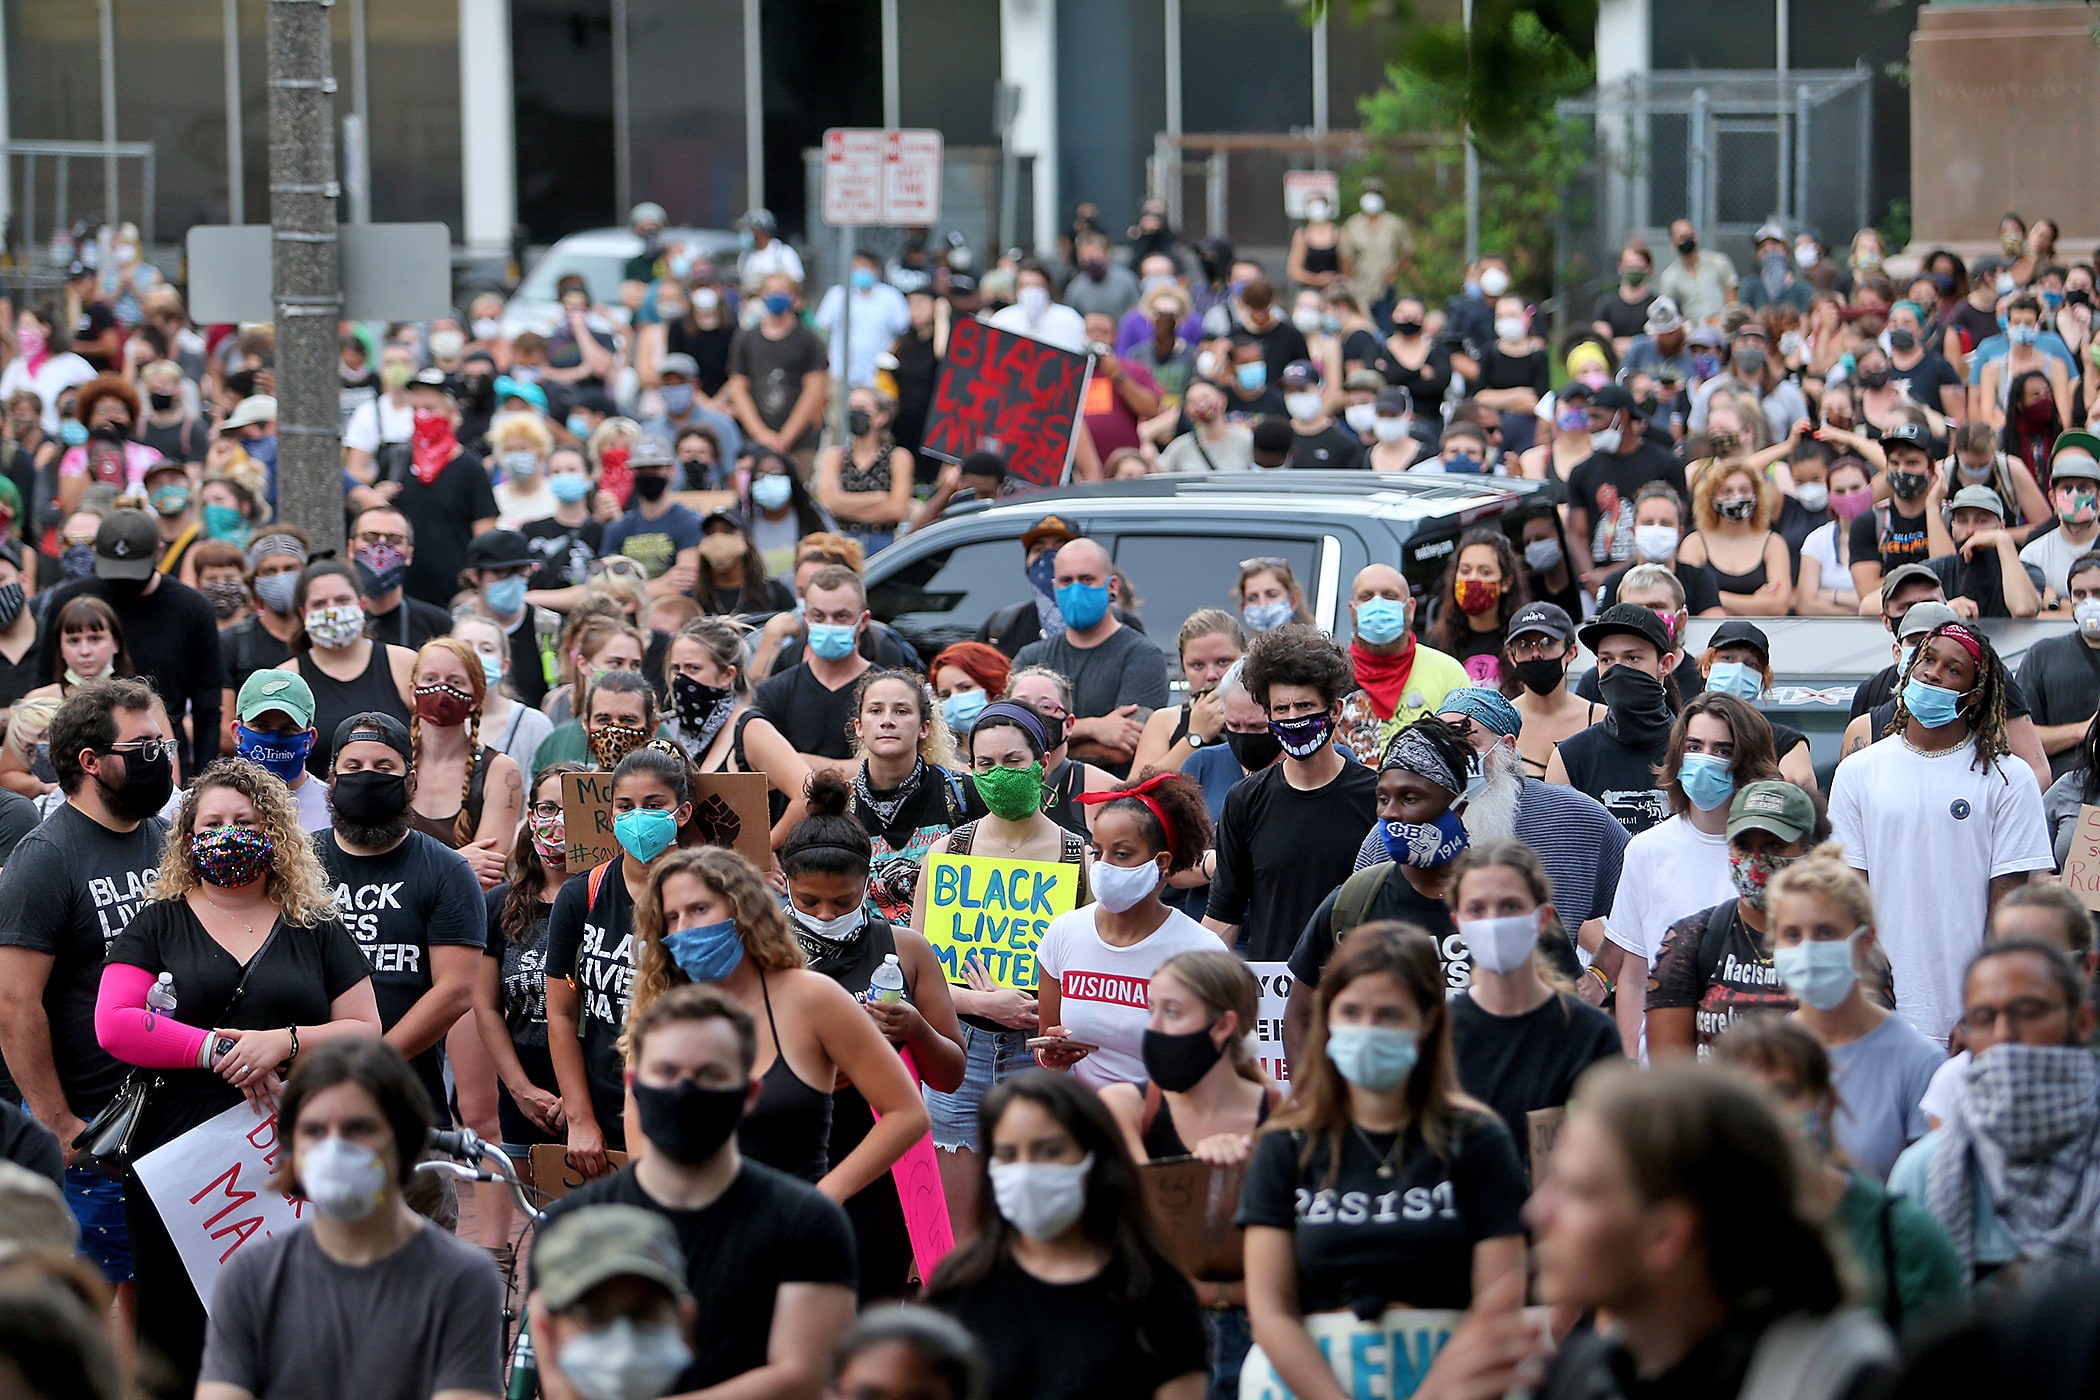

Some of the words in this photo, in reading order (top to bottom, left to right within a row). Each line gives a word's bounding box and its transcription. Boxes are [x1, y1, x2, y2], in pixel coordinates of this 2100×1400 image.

[948, 316, 1085, 416] BLACK
[934, 367, 1071, 450] LIVES
[264, 748, 296, 761] Trinity
[1437, 836, 1463, 860] 1914
[334, 881, 405, 911] ACK
[934, 864, 1058, 916] BLACK
[952, 911, 1050, 952] LIVES
[1068, 974, 1151, 1005] VISIONA
